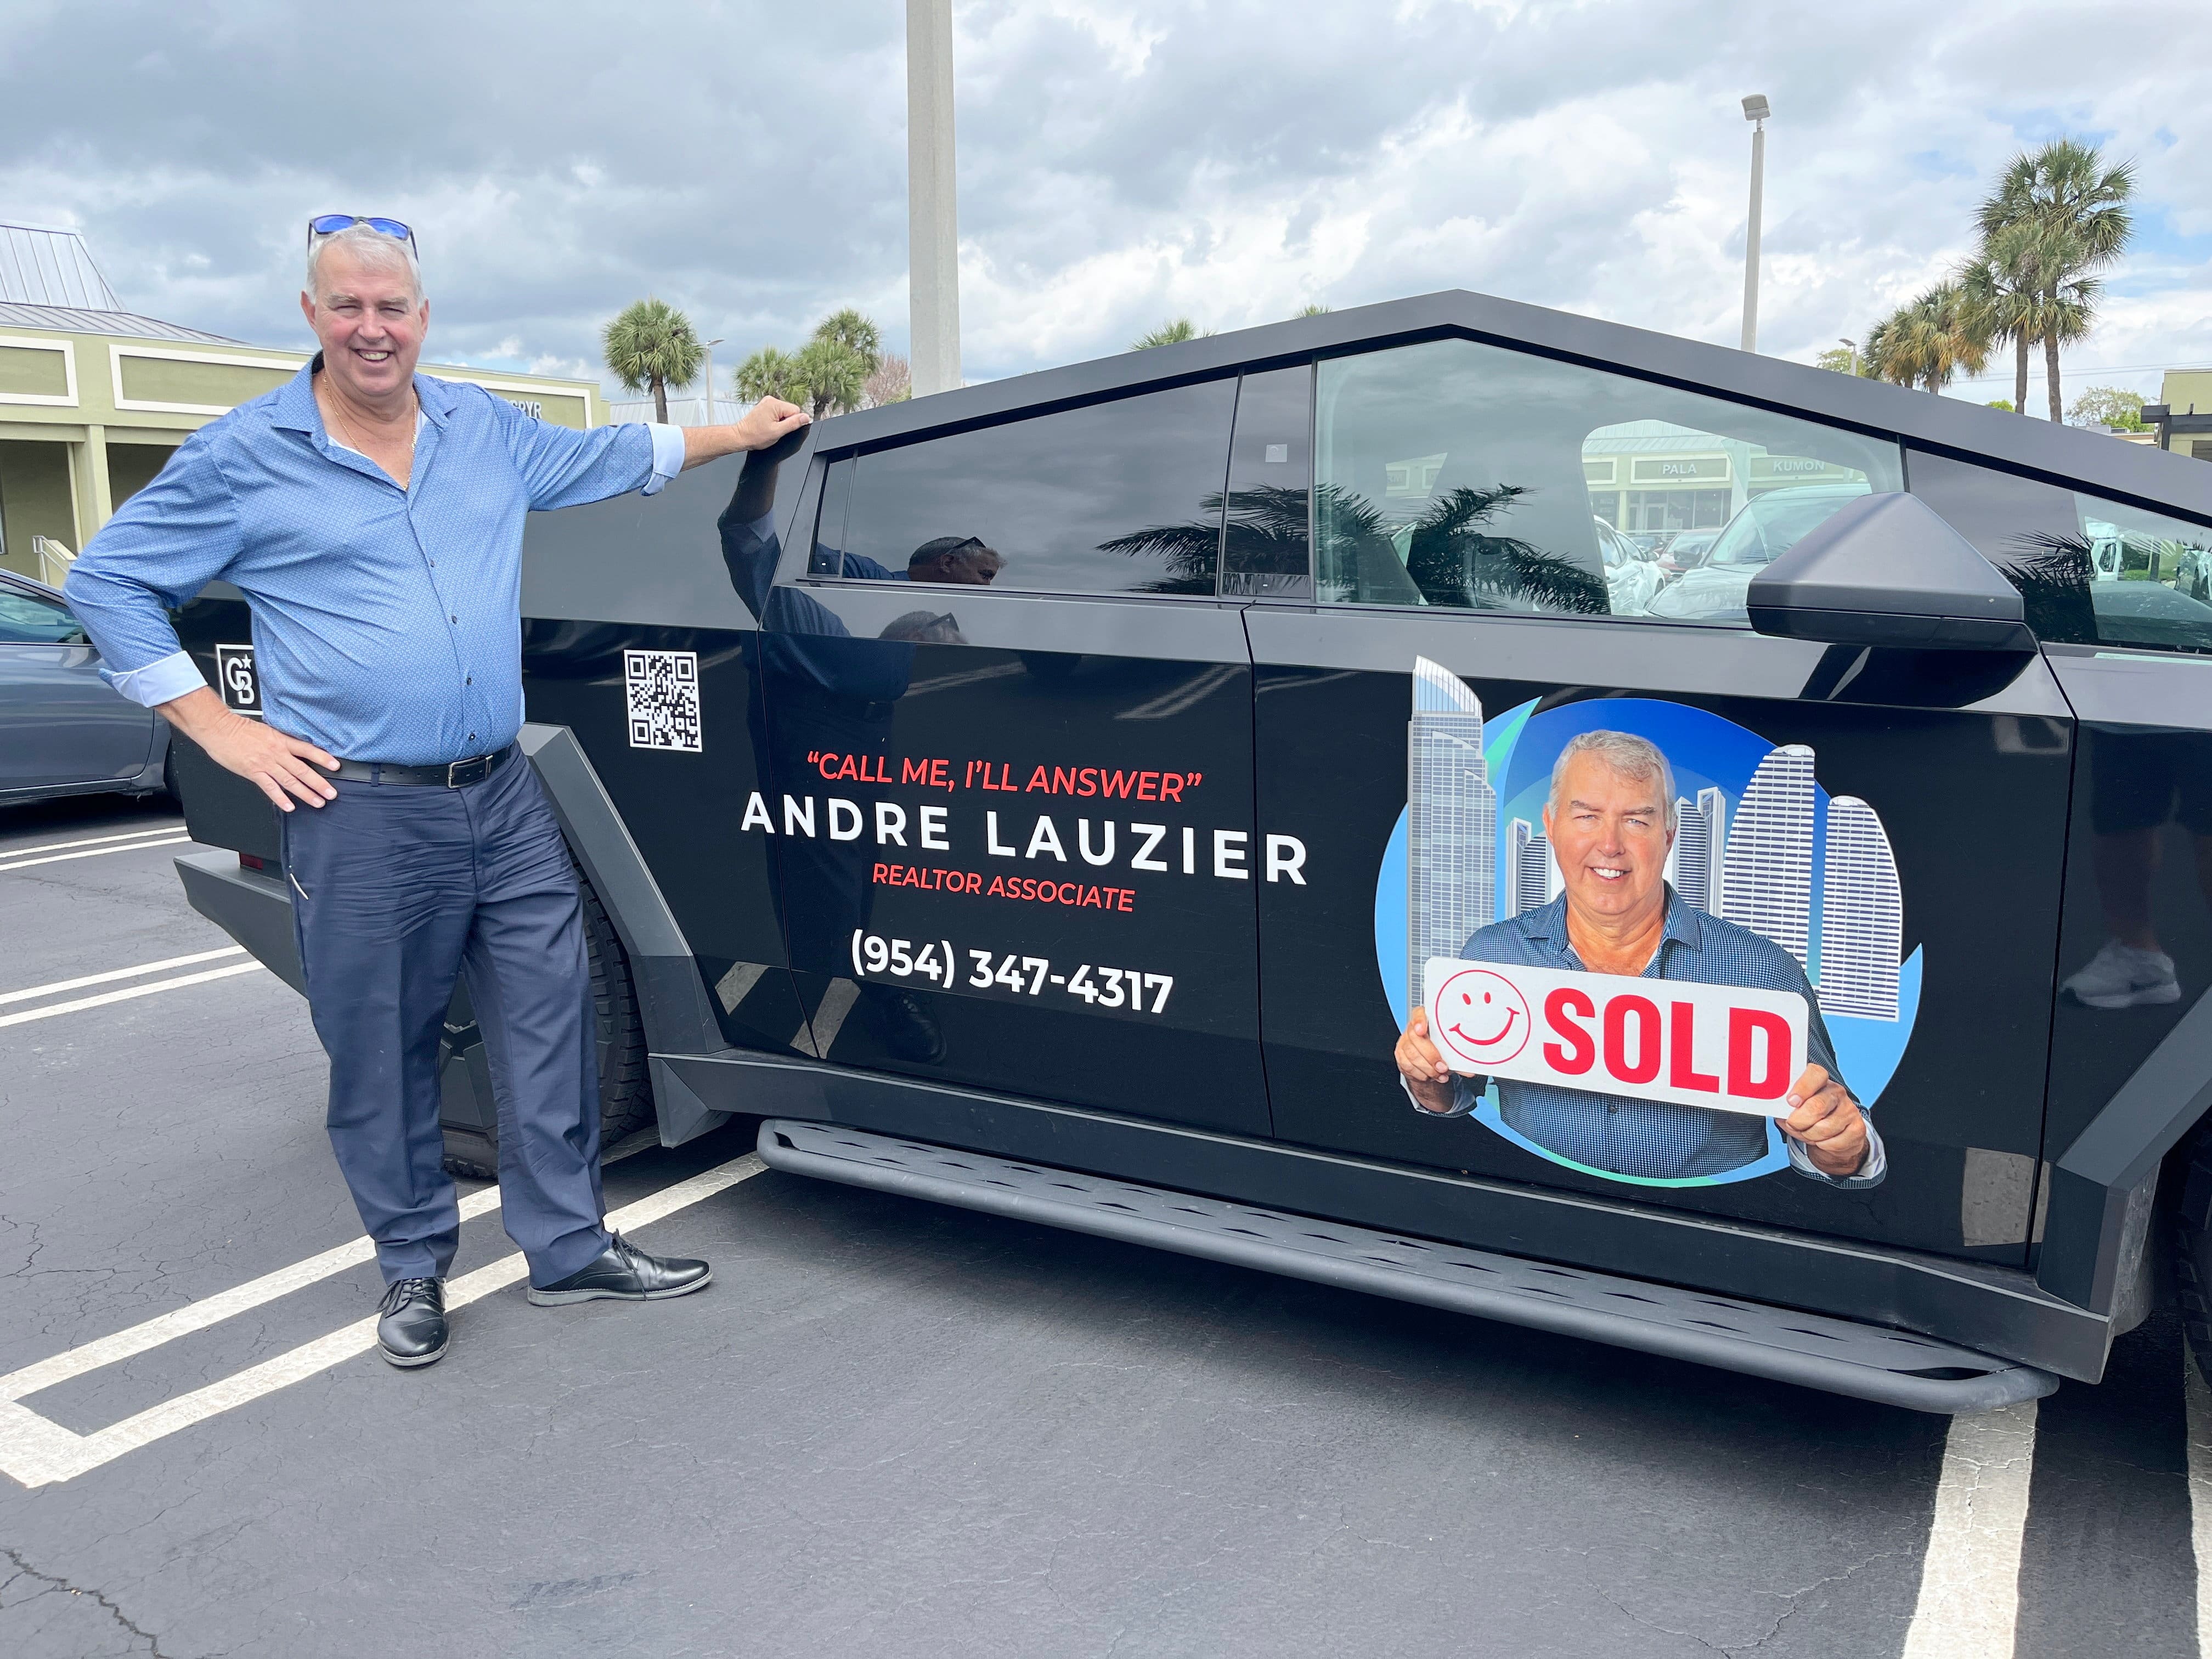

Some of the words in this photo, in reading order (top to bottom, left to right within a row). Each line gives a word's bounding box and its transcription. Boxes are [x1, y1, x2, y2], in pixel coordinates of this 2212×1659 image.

[1662, 464, 1697, 475] PALA
[1773, 460, 1825, 472] KUMON
[807, 751, 893, 783] “CALL
[901, 758, 955, 792] ME,
[965, 760, 1018, 792] I’LL
[1025, 765, 1203, 803] ANSWER”
[741, 791, 950, 850] ANDRE
[986, 811, 1307, 885] LAUZIER
[872, 863, 983, 894] REALTOR
[987, 876, 1136, 912] ASSOCIATE
[852, 929, 955, 989] (954)
[968, 949, 1173, 1014] 347-4317
[1543, 987, 1792, 1100] SOLD
